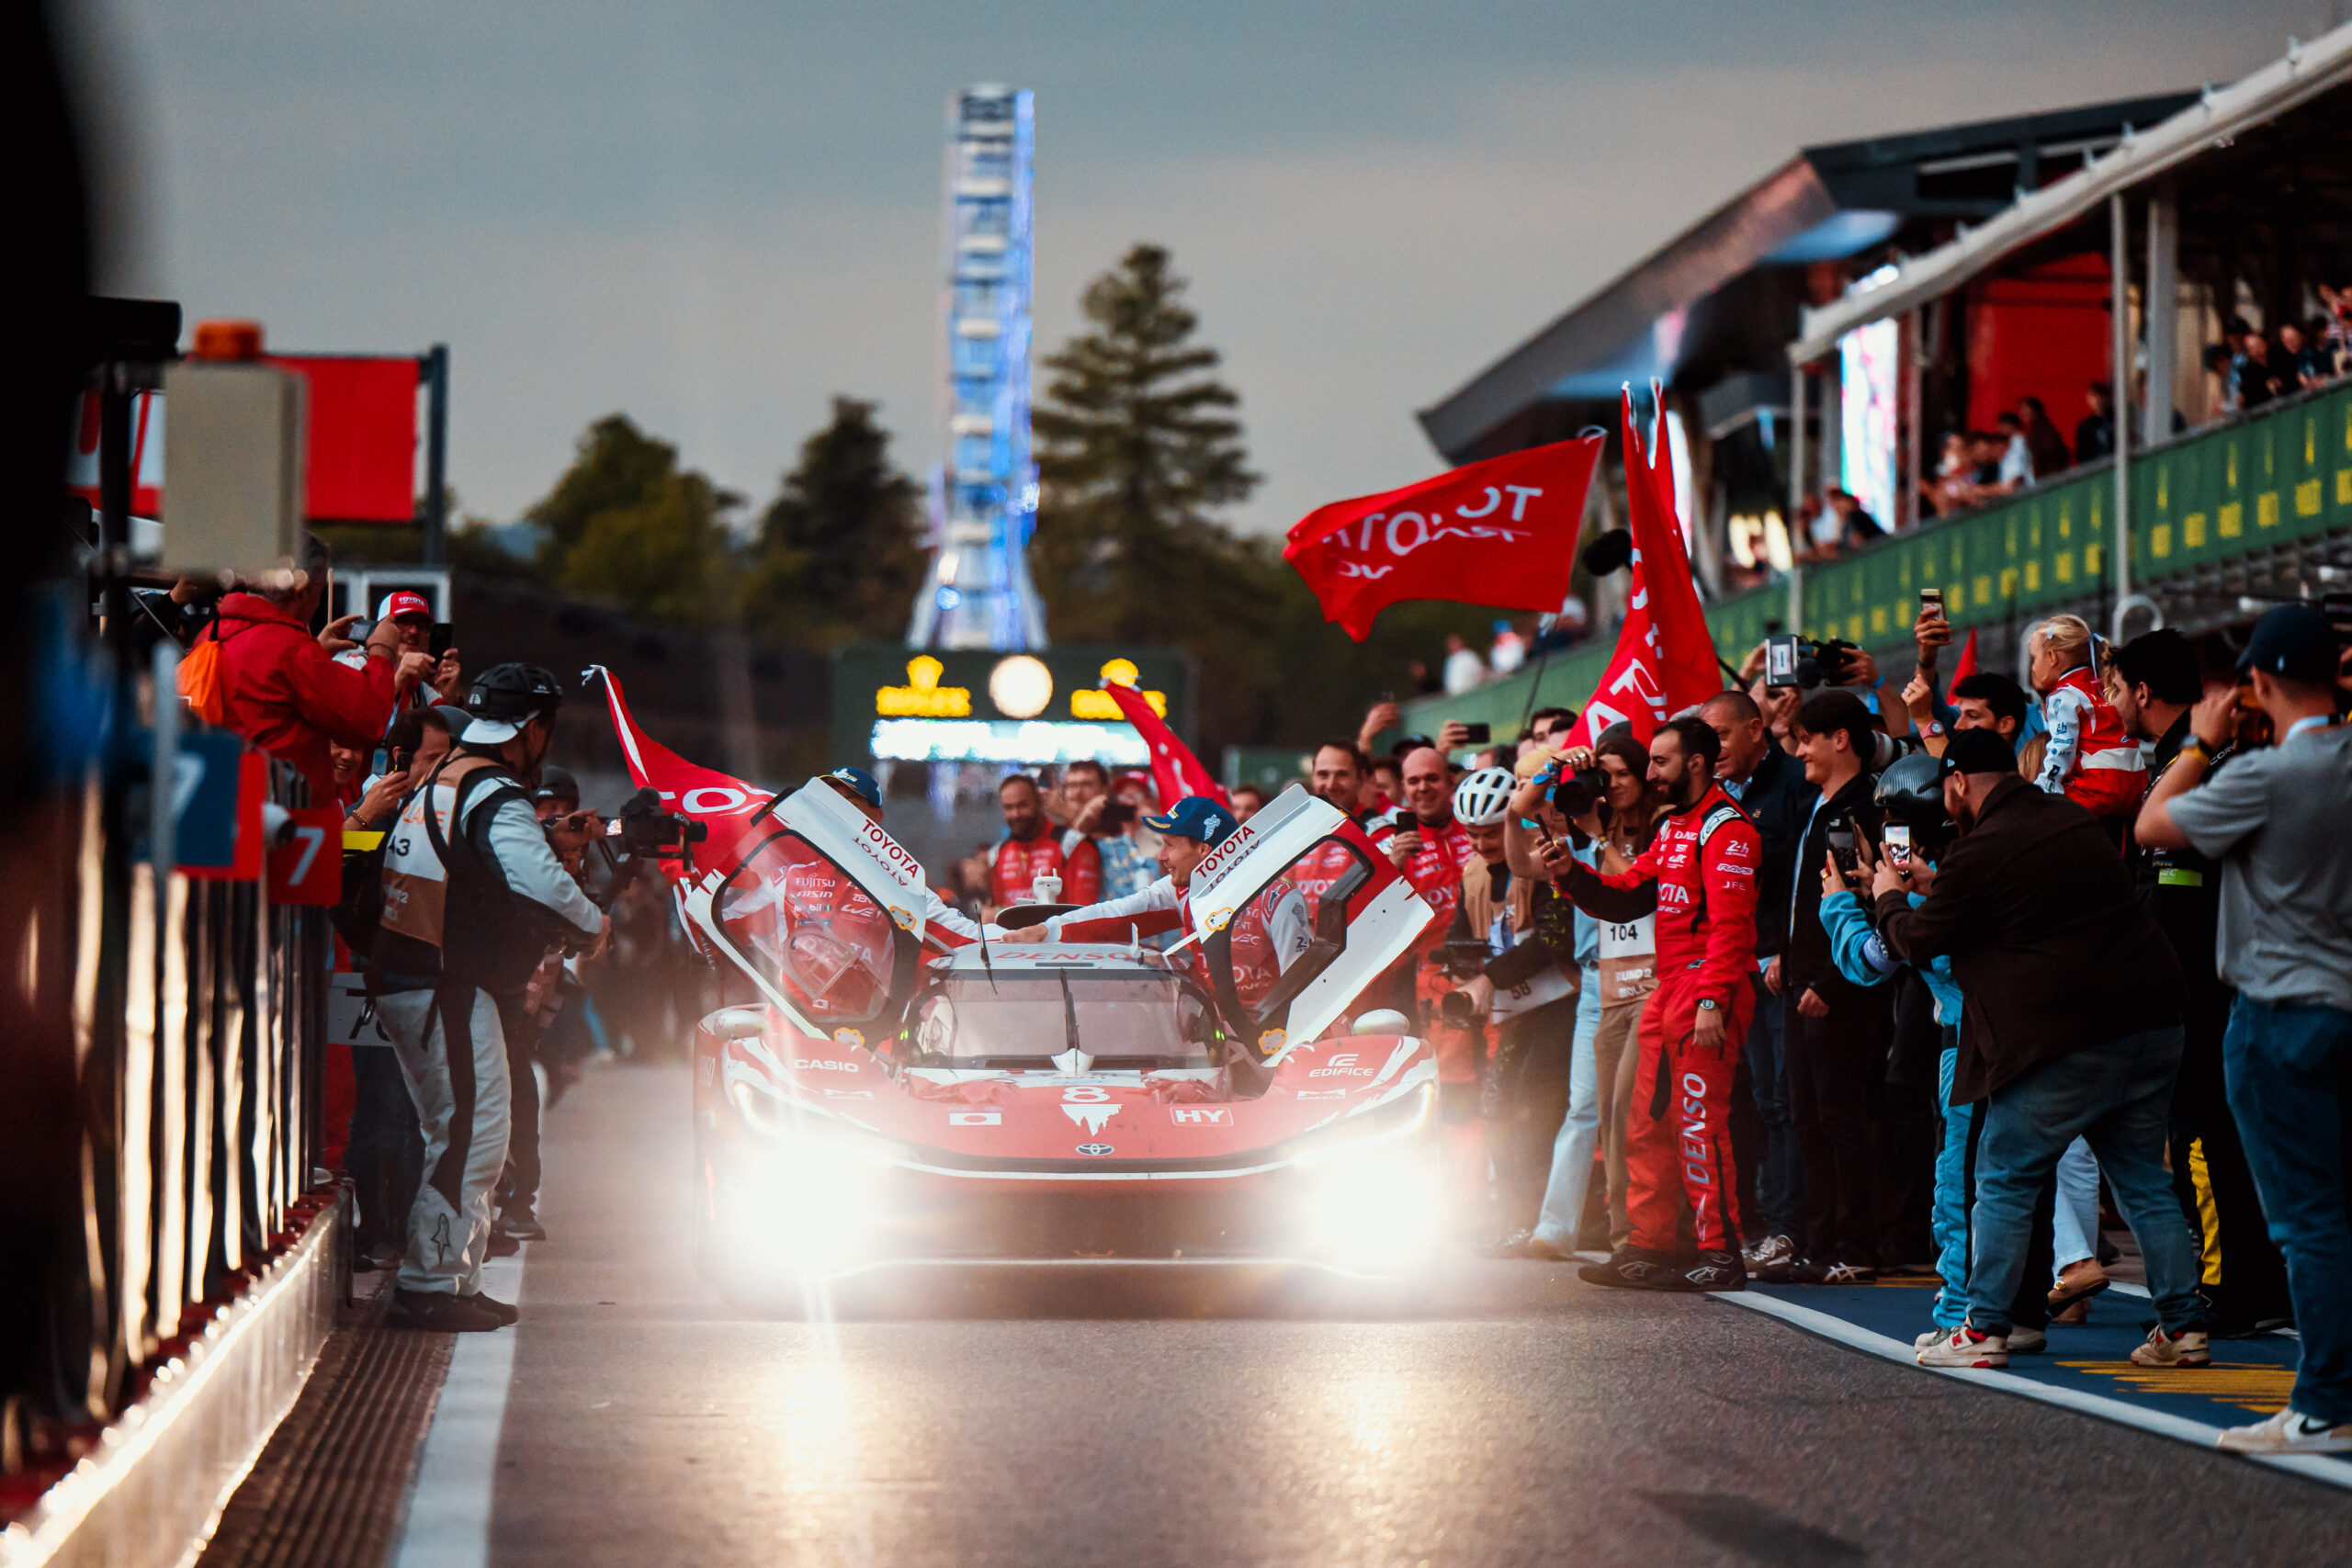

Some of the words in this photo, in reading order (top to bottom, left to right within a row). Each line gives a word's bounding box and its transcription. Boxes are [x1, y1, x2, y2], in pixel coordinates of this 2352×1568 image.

[863, 818, 919, 878] TOYOTA
[1195, 826, 1255, 878] TOYOTA
[288, 827, 324, 886] 7
[1716, 863, 1753, 874] RAYS
[795, 873, 835, 888] FUJITSU
[1723, 881, 1747, 891] JFE
[1610, 924, 1638, 942] 104
[996, 952, 1132, 961] DENSO
[793, 1058, 859, 1073] CASIO
[1308, 1067, 1375, 1078] EDIFICE
[1062, 1086, 1111, 1102] 8
[1175, 1109, 1225, 1122] HY
[1682, 1073, 1710, 1185] DENSO
